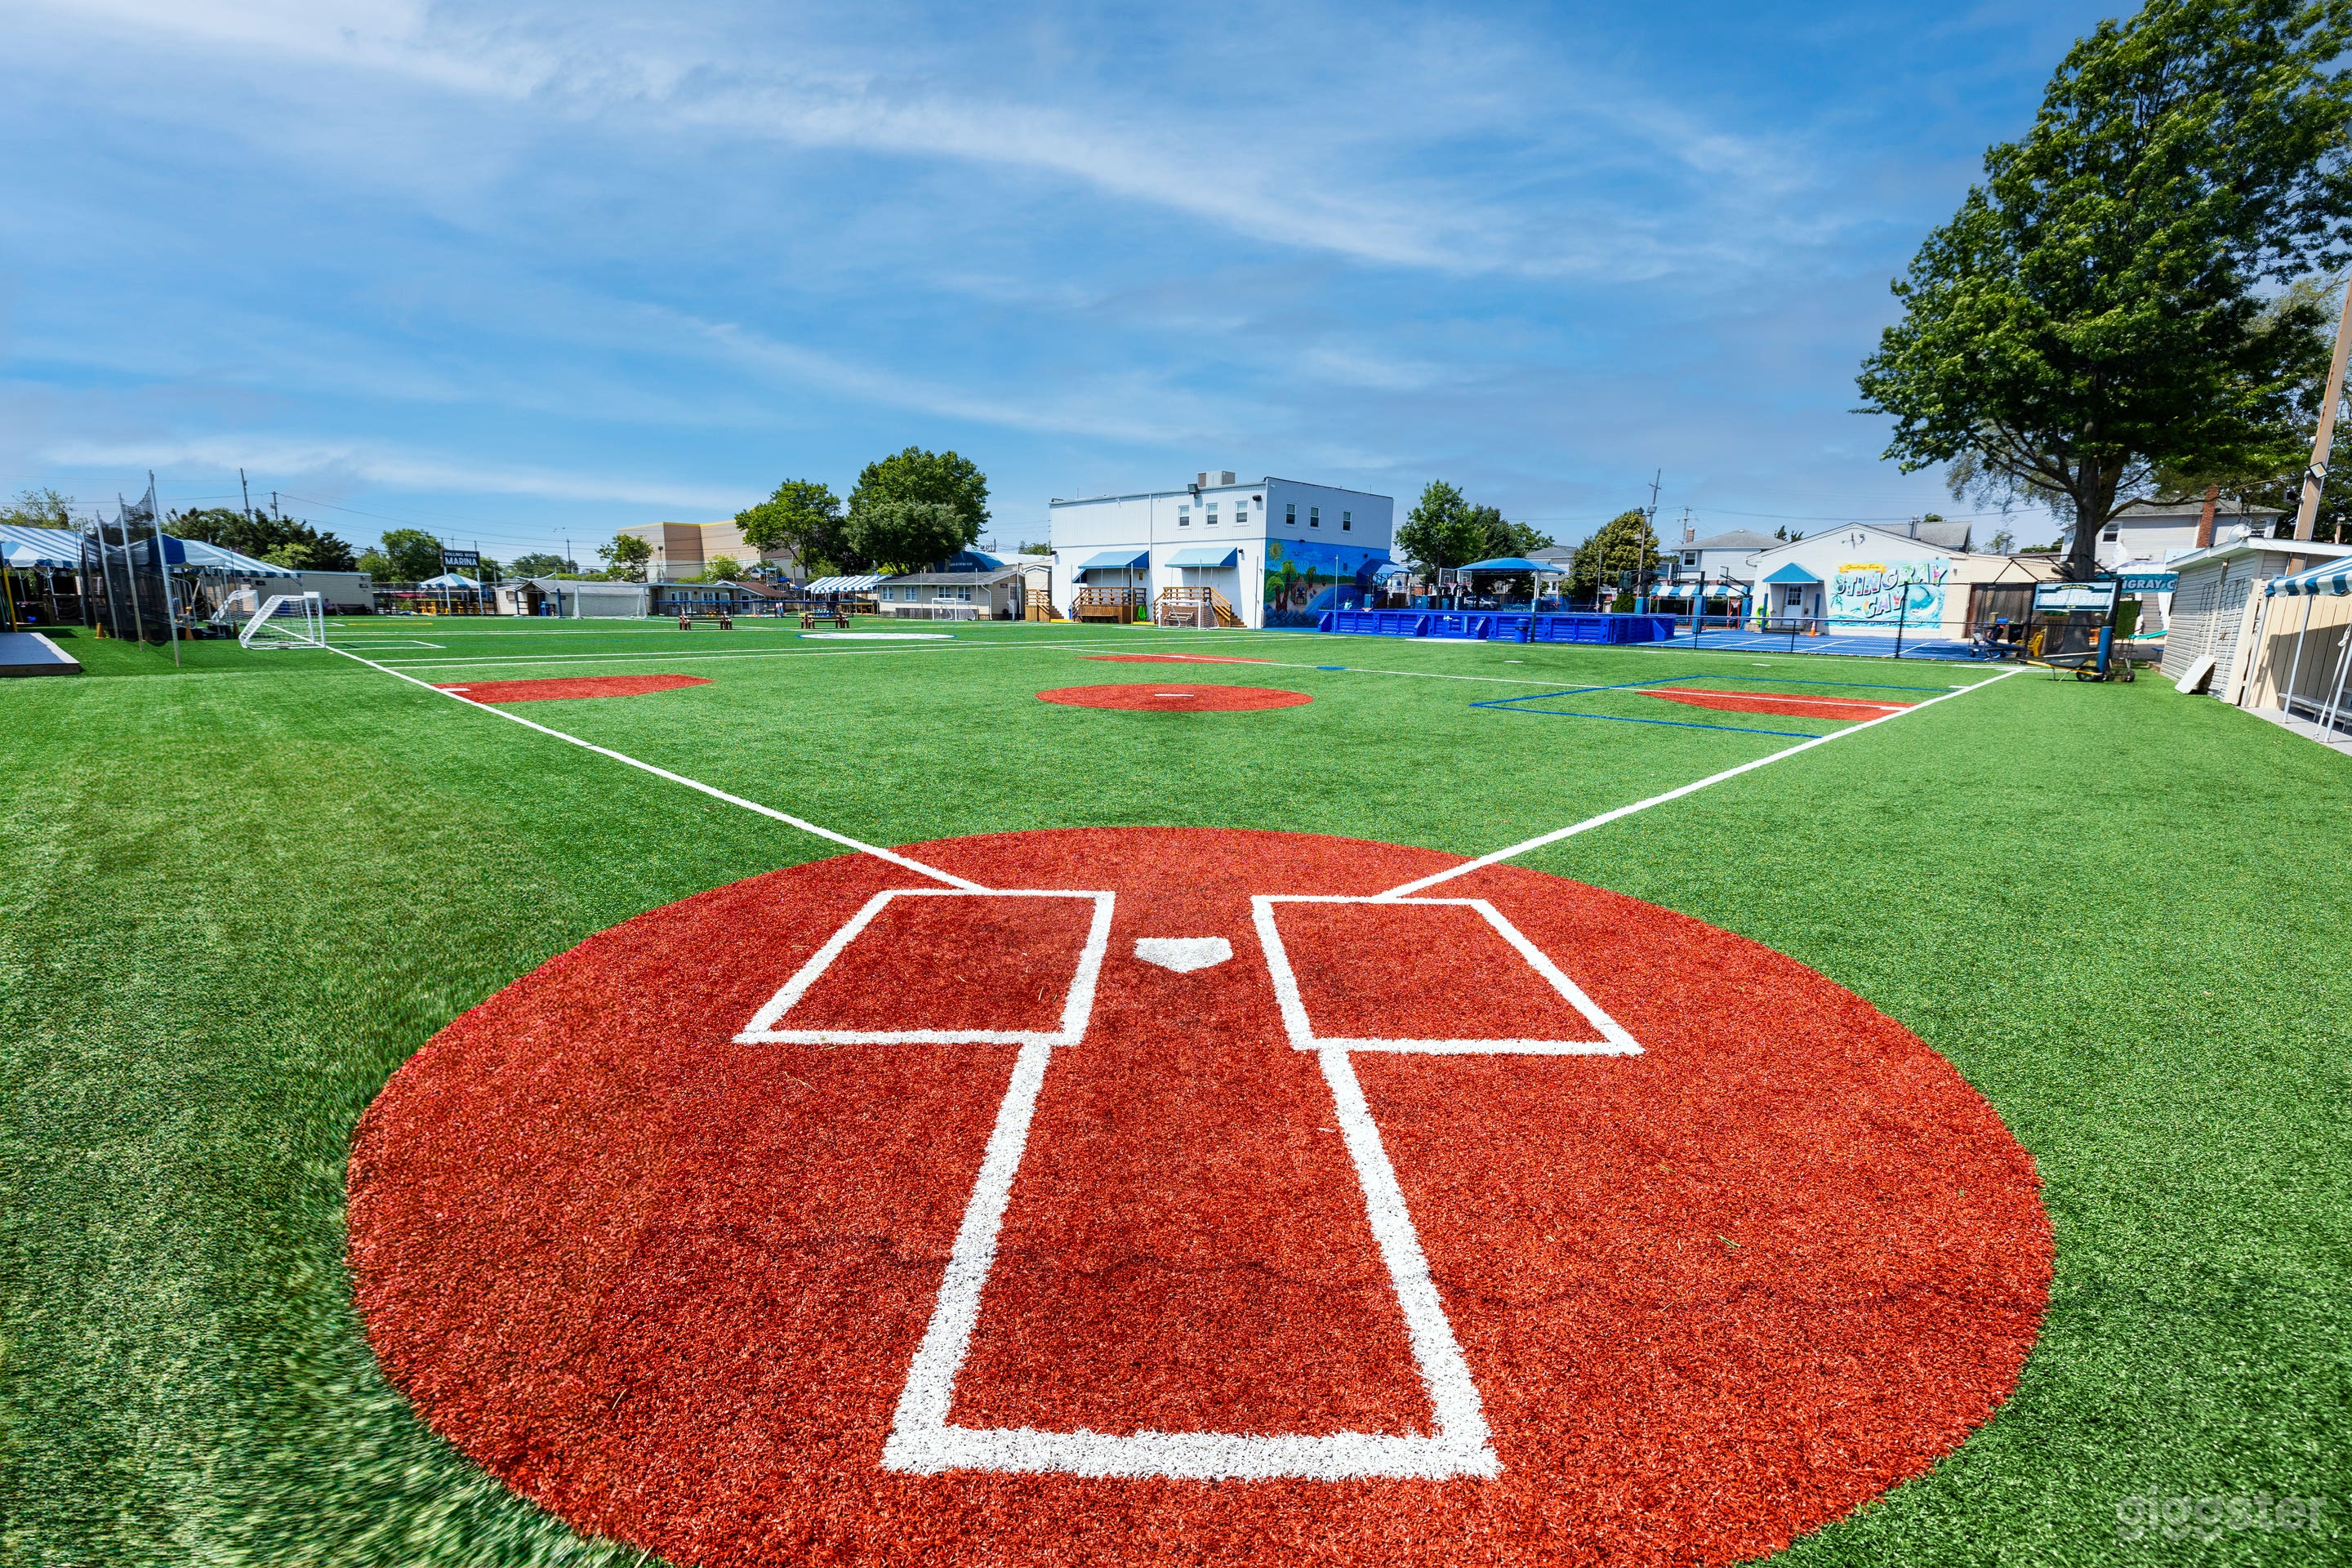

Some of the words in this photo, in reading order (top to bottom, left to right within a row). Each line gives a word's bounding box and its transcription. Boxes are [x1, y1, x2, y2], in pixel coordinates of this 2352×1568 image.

[444, 557, 478, 566] MARINA
[1834, 563, 1948, 596] STINGRAY
[1863, 590, 1906, 618] CAY
